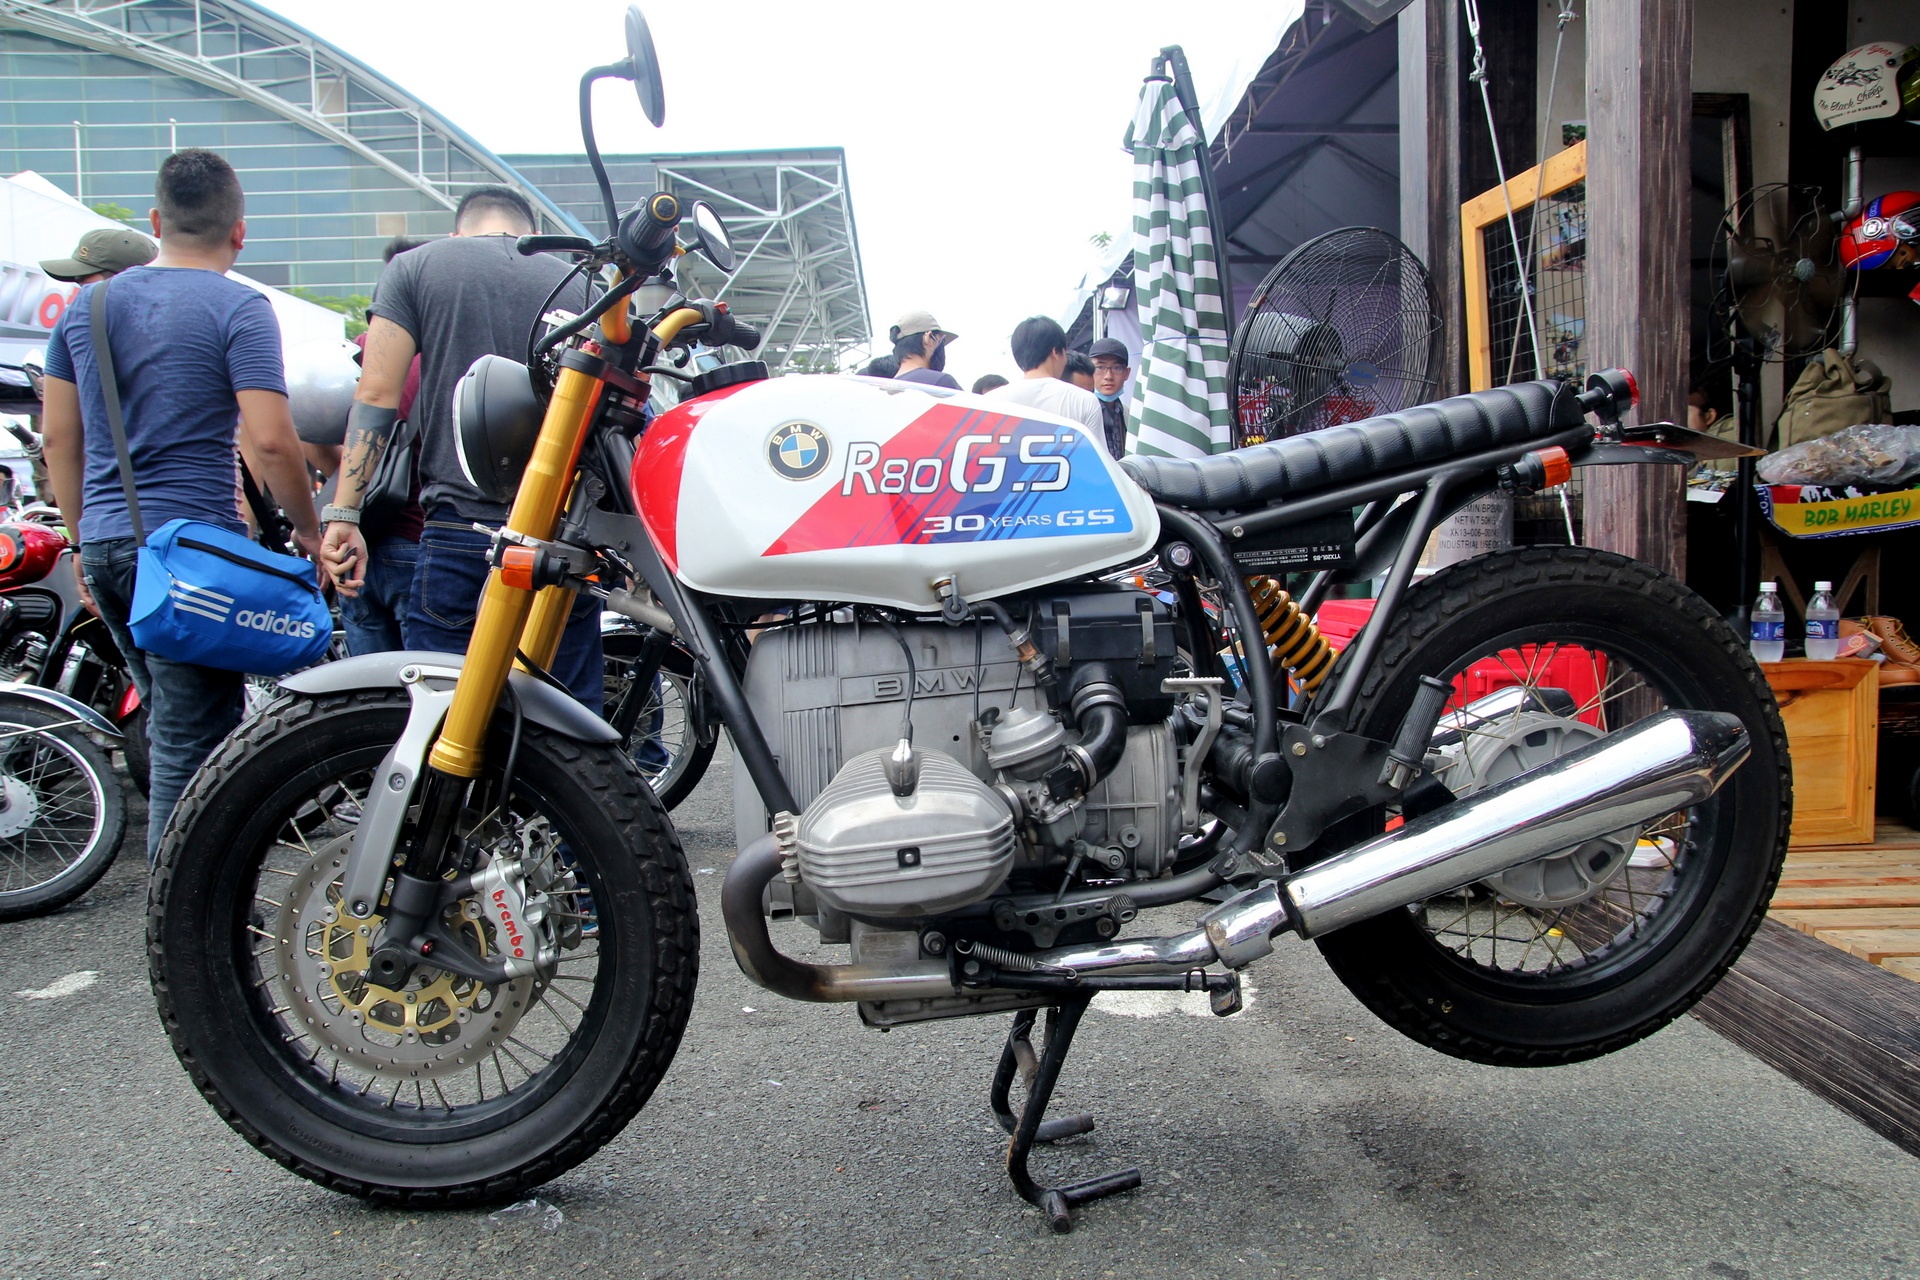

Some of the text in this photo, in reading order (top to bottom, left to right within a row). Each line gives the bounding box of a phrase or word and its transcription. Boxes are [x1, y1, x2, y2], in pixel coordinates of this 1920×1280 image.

[1830, 98, 1855, 112] Black
[1857, 85, 1884, 105] Sheep
[79, 246, 90, 257] S
[772, 424, 823, 446] BMW
[922, 508, 1115, 535] 30 YEARS GS
[1454, 516, 1468, 525] NET
[1469, 516, 1480, 525] WT
[1804, 497, 1912, 527] BOB MARLEY
[1439, 540, 1478, 549] INDUSTRIAL
[1480, 540, 1492, 549] USE
[235, 609, 316, 639] adidas
[873, 667, 987, 698] BMW
[492, 889, 525, 958] brembo
